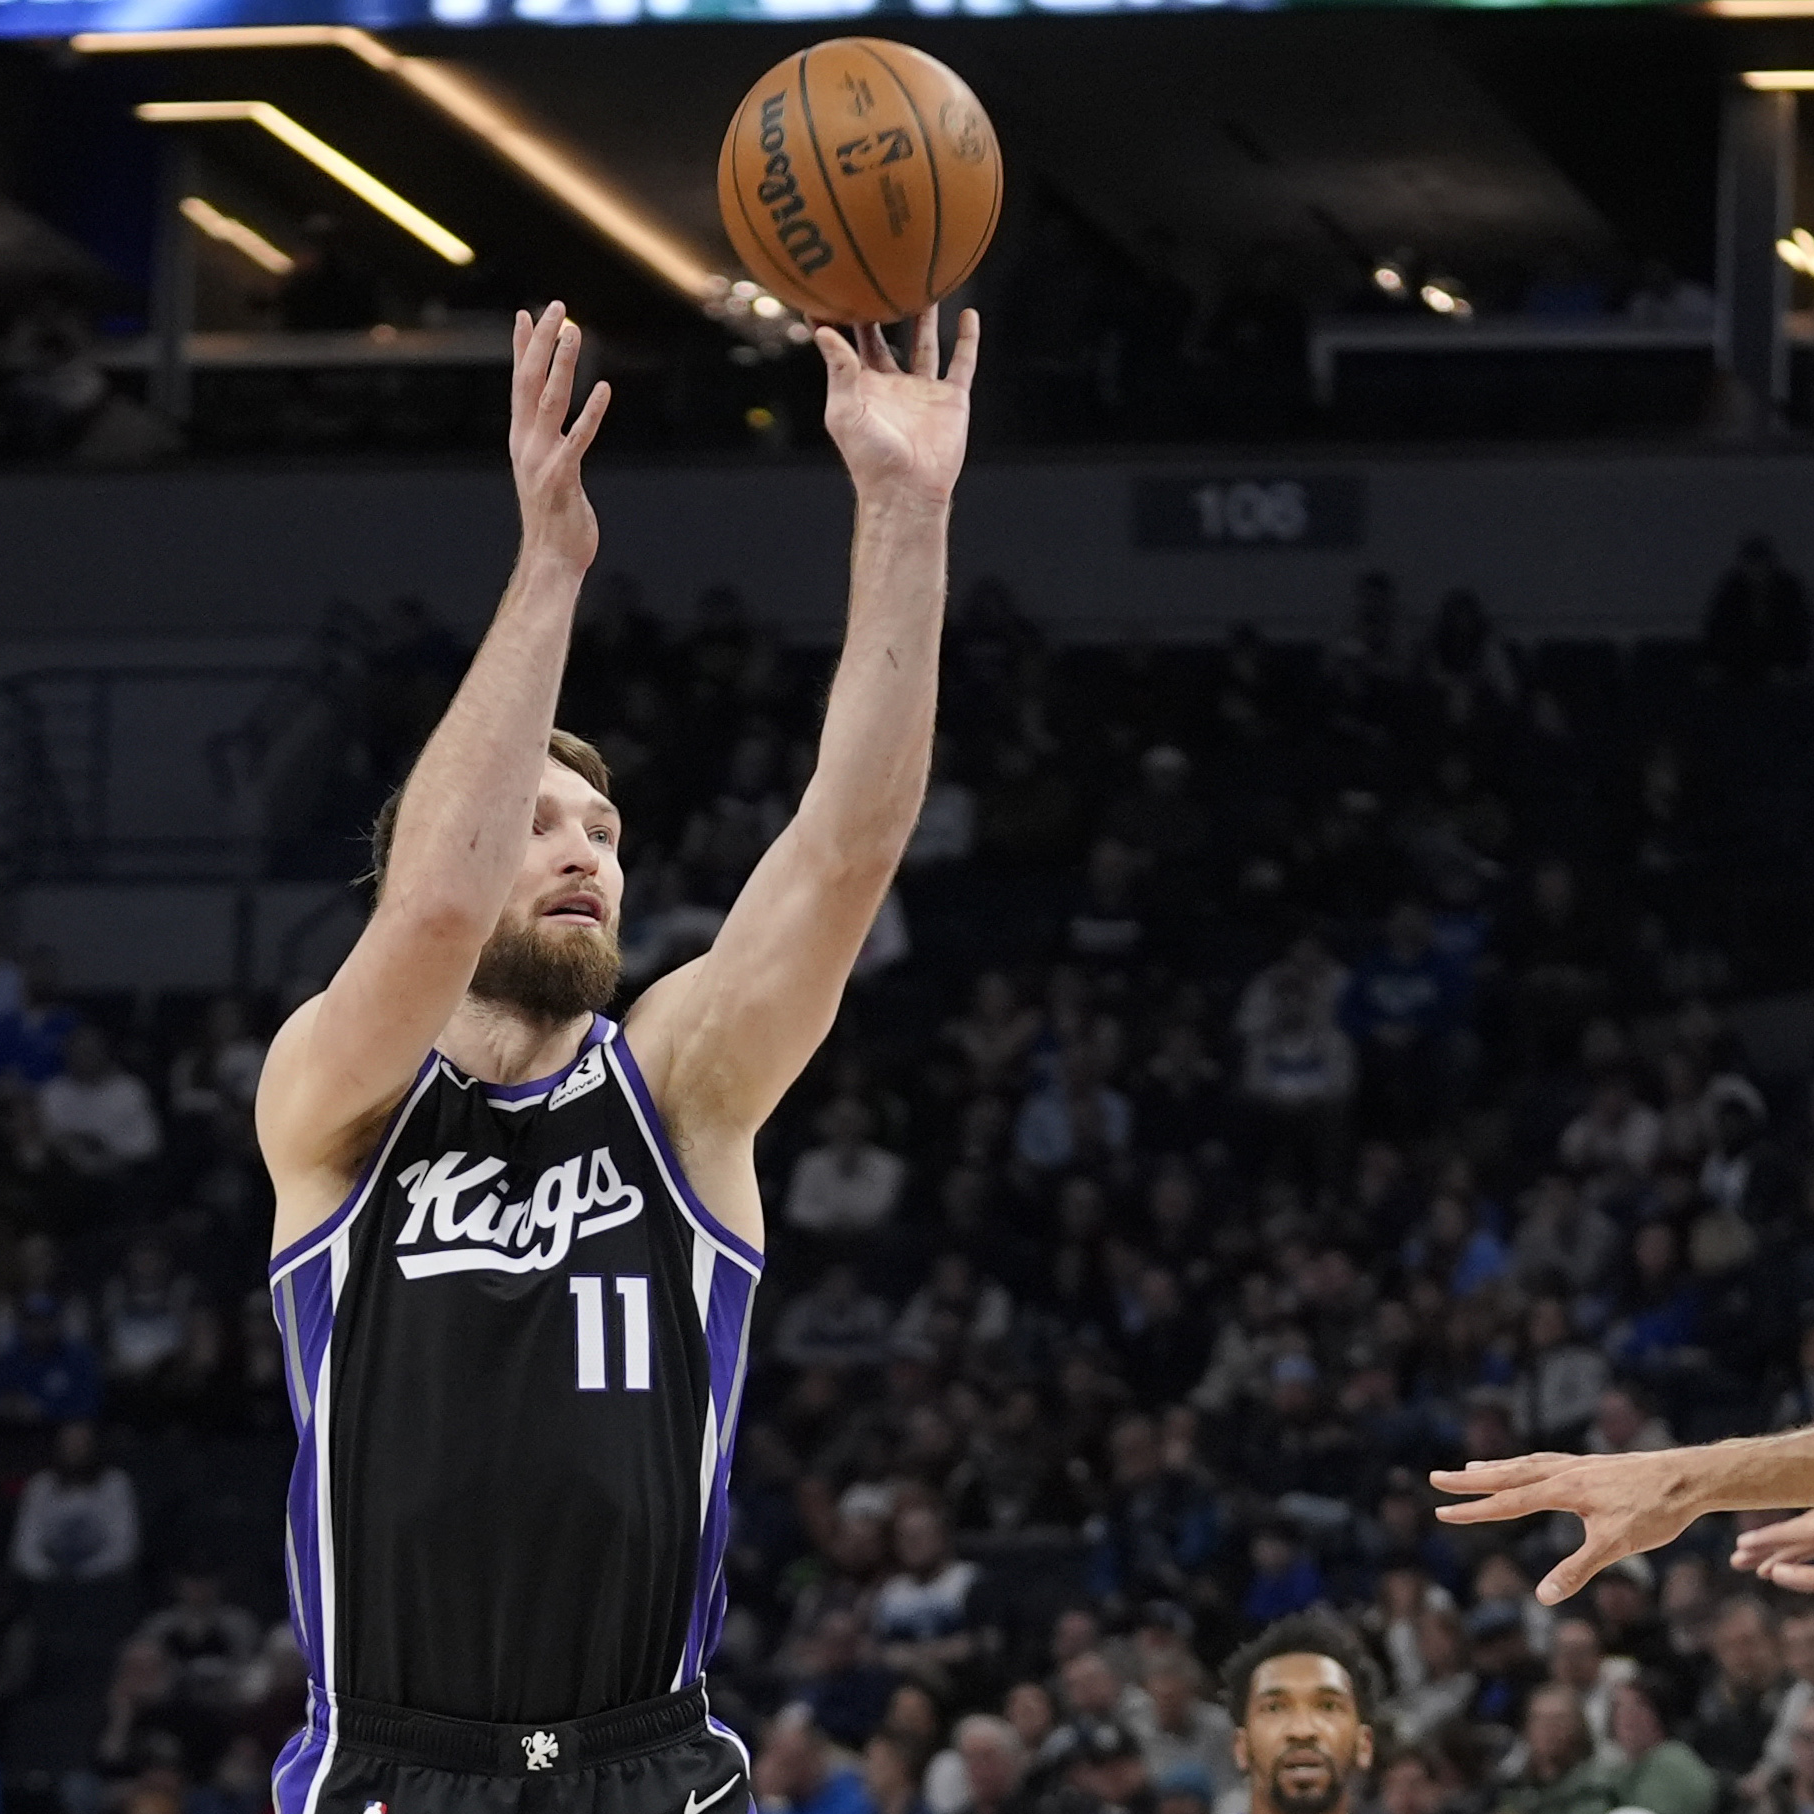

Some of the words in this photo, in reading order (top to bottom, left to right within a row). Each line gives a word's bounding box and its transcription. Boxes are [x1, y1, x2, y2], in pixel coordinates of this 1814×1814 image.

[757, 90, 834, 276] Wilson
[395, 1146, 644, 1281] Kings
[569, 1273, 652, 1392] 11
